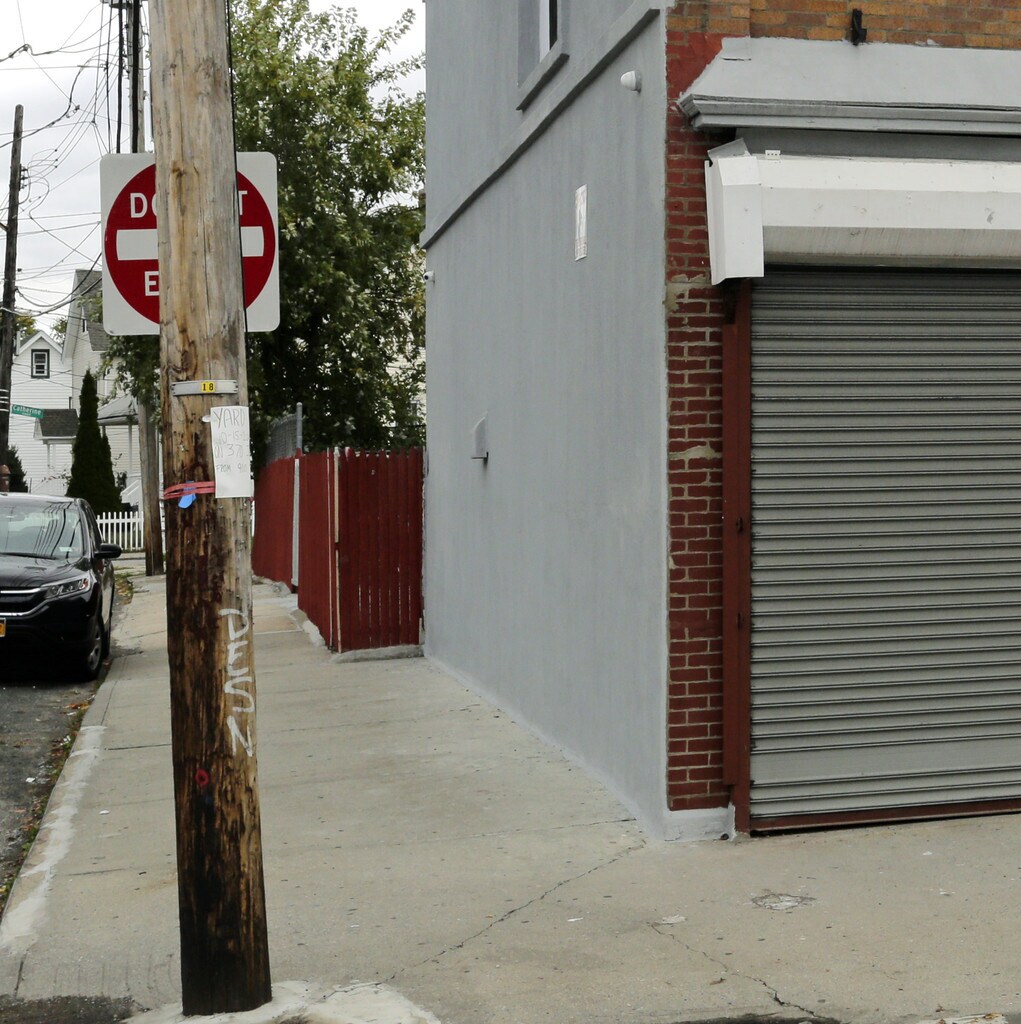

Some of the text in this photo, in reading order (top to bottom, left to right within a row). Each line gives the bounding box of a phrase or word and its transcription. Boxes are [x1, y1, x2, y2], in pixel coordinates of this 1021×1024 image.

[202, 382, 214, 391] 18
[13, 404, 42, 416] Catherine
[213, 408, 246, 429] YARD
